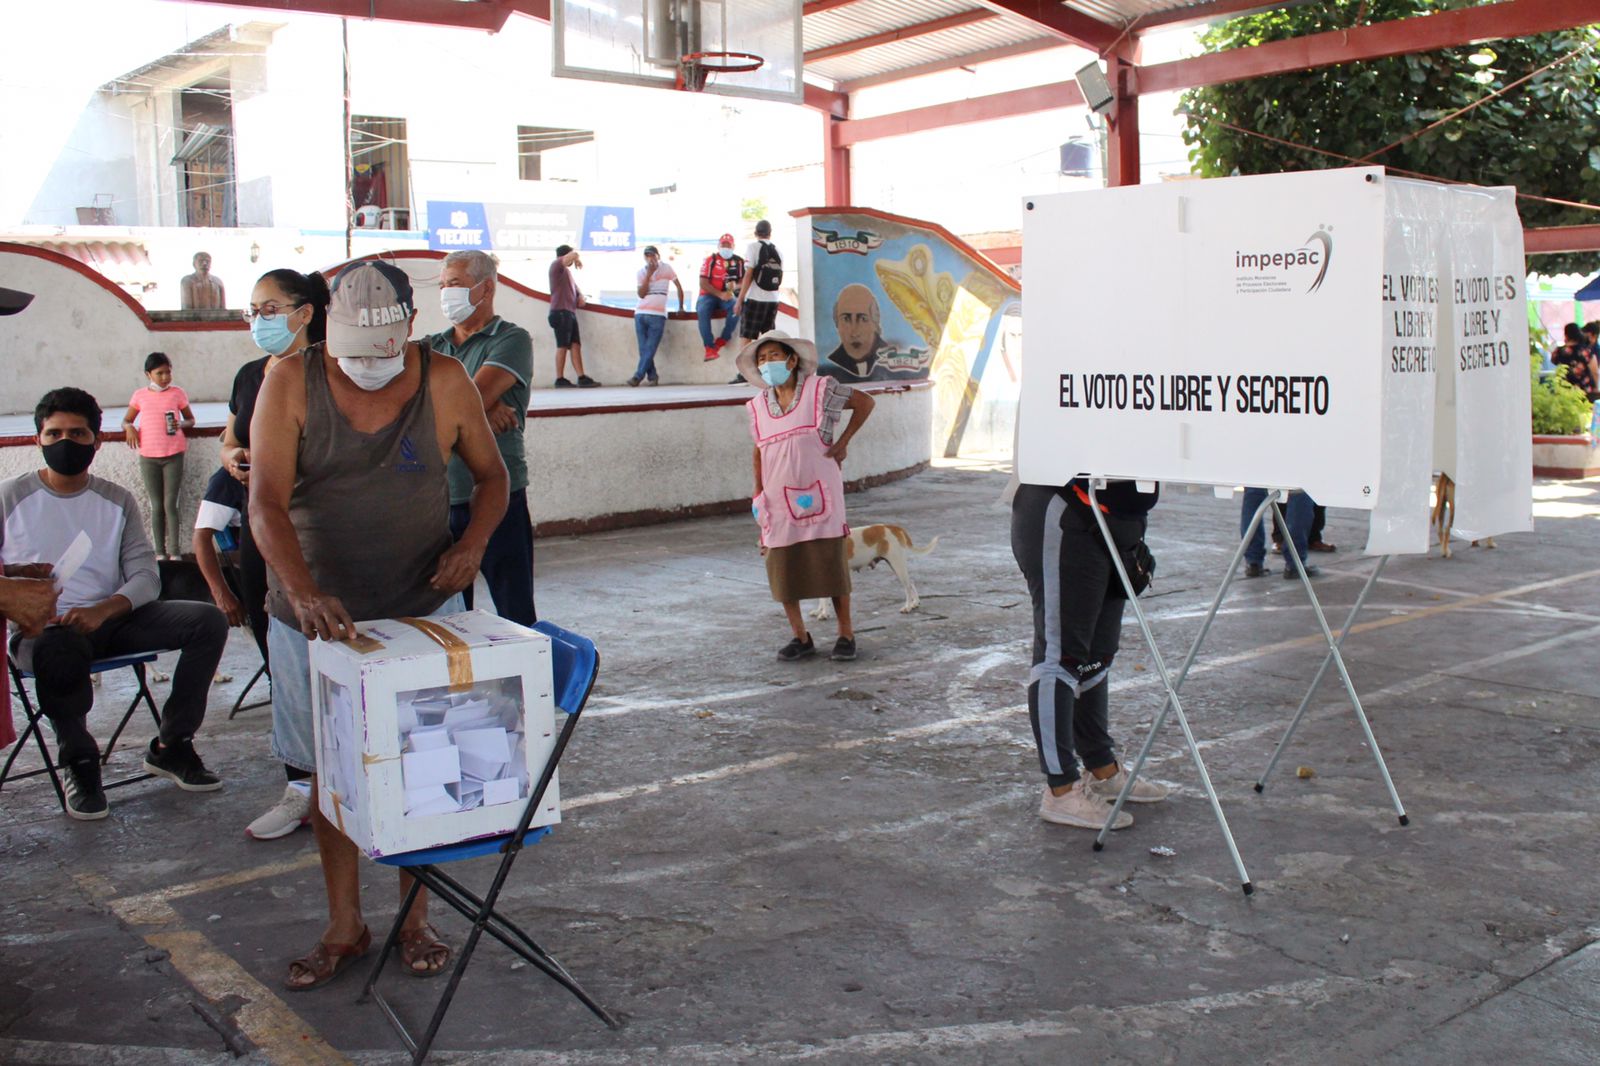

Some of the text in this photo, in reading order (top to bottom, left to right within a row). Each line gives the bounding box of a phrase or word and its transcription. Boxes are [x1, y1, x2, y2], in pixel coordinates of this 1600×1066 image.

[437, 229, 483, 245] TECATE
[590, 231, 630, 247] TECATE
[1236, 250, 1319, 271] impepac
[1382, 274, 1396, 301] EL
[1401, 275, 1426, 302] VOTO
[1455, 279, 1466, 303] EL
[1495, 275, 1516, 300] ES
[358, 307, 370, 327] A
[1394, 310, 1425, 338] LIBRE
[1464, 309, 1501, 337] LIBRE Y
[1391, 346, 1437, 373] SECRETO
[1461, 341, 1510, 371] SECRETO
[1060, 373, 1329, 415] EL VOTO ES LIBRE Y SECRETO
